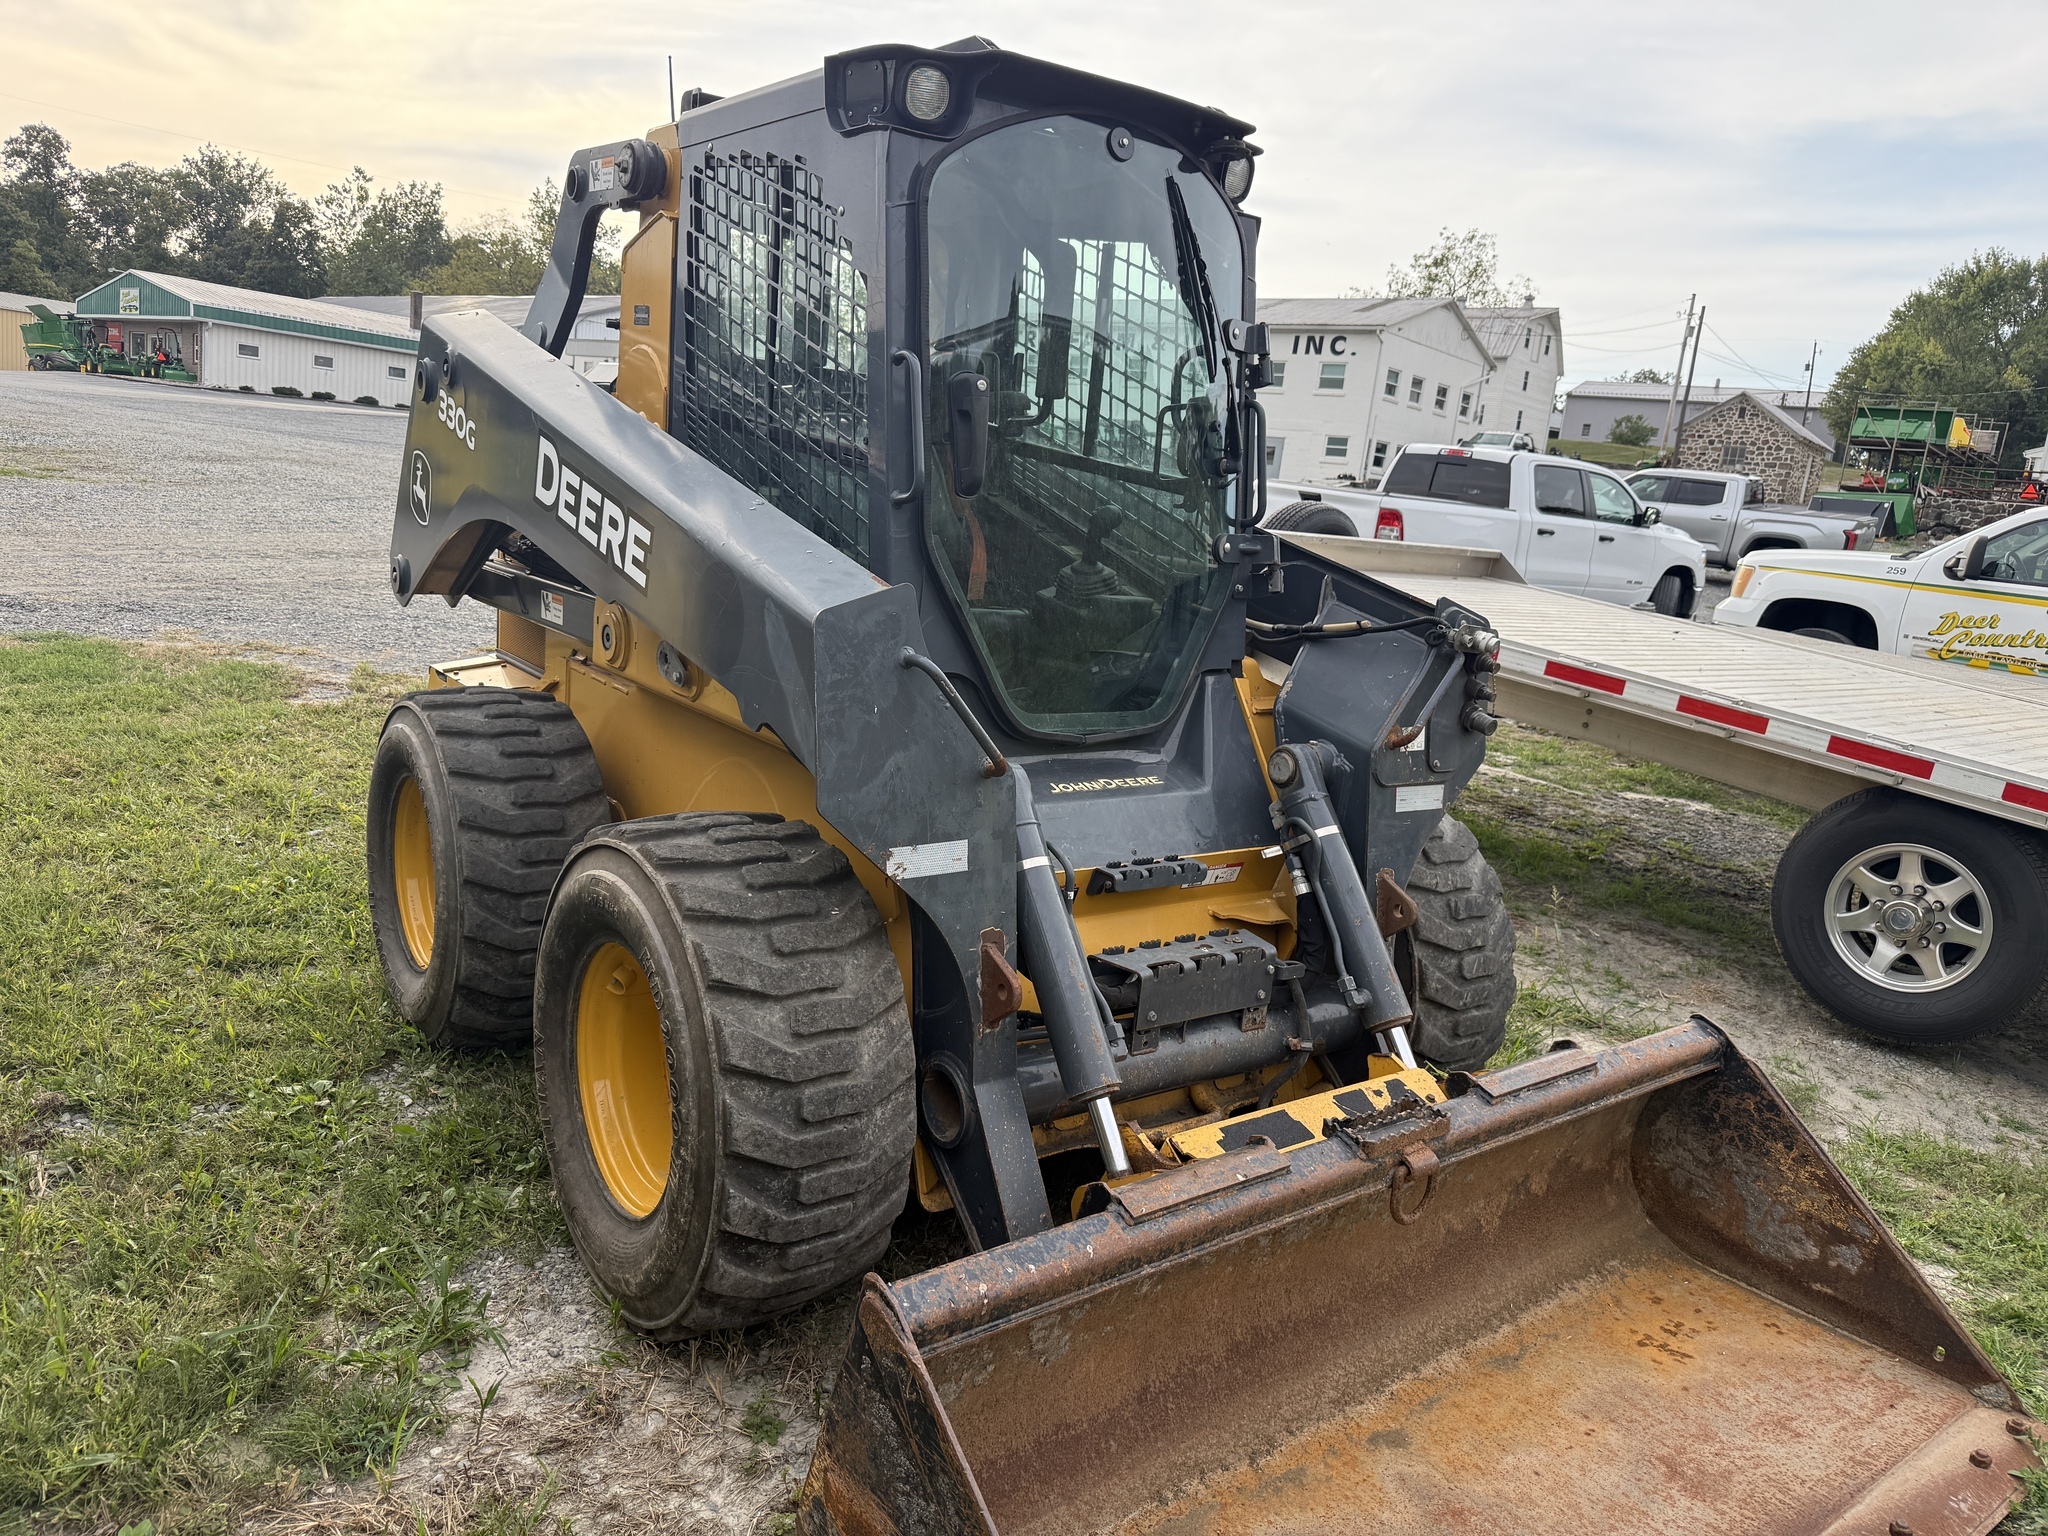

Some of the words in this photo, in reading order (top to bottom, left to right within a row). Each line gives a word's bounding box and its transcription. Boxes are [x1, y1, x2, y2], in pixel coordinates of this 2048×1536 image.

[1291, 335, 1357, 356] INC.
[438, 389, 476, 451] 330G
[535, 435, 652, 589] DEERE
[1886, 566, 1907, 576] 259
[1928, 611, 2001, 636] Deer
[1938, 629, 2048, 660] Countr
[1049, 781, 1100, 794] JOHN
[1096, 776, 1164, 789] DEERE
